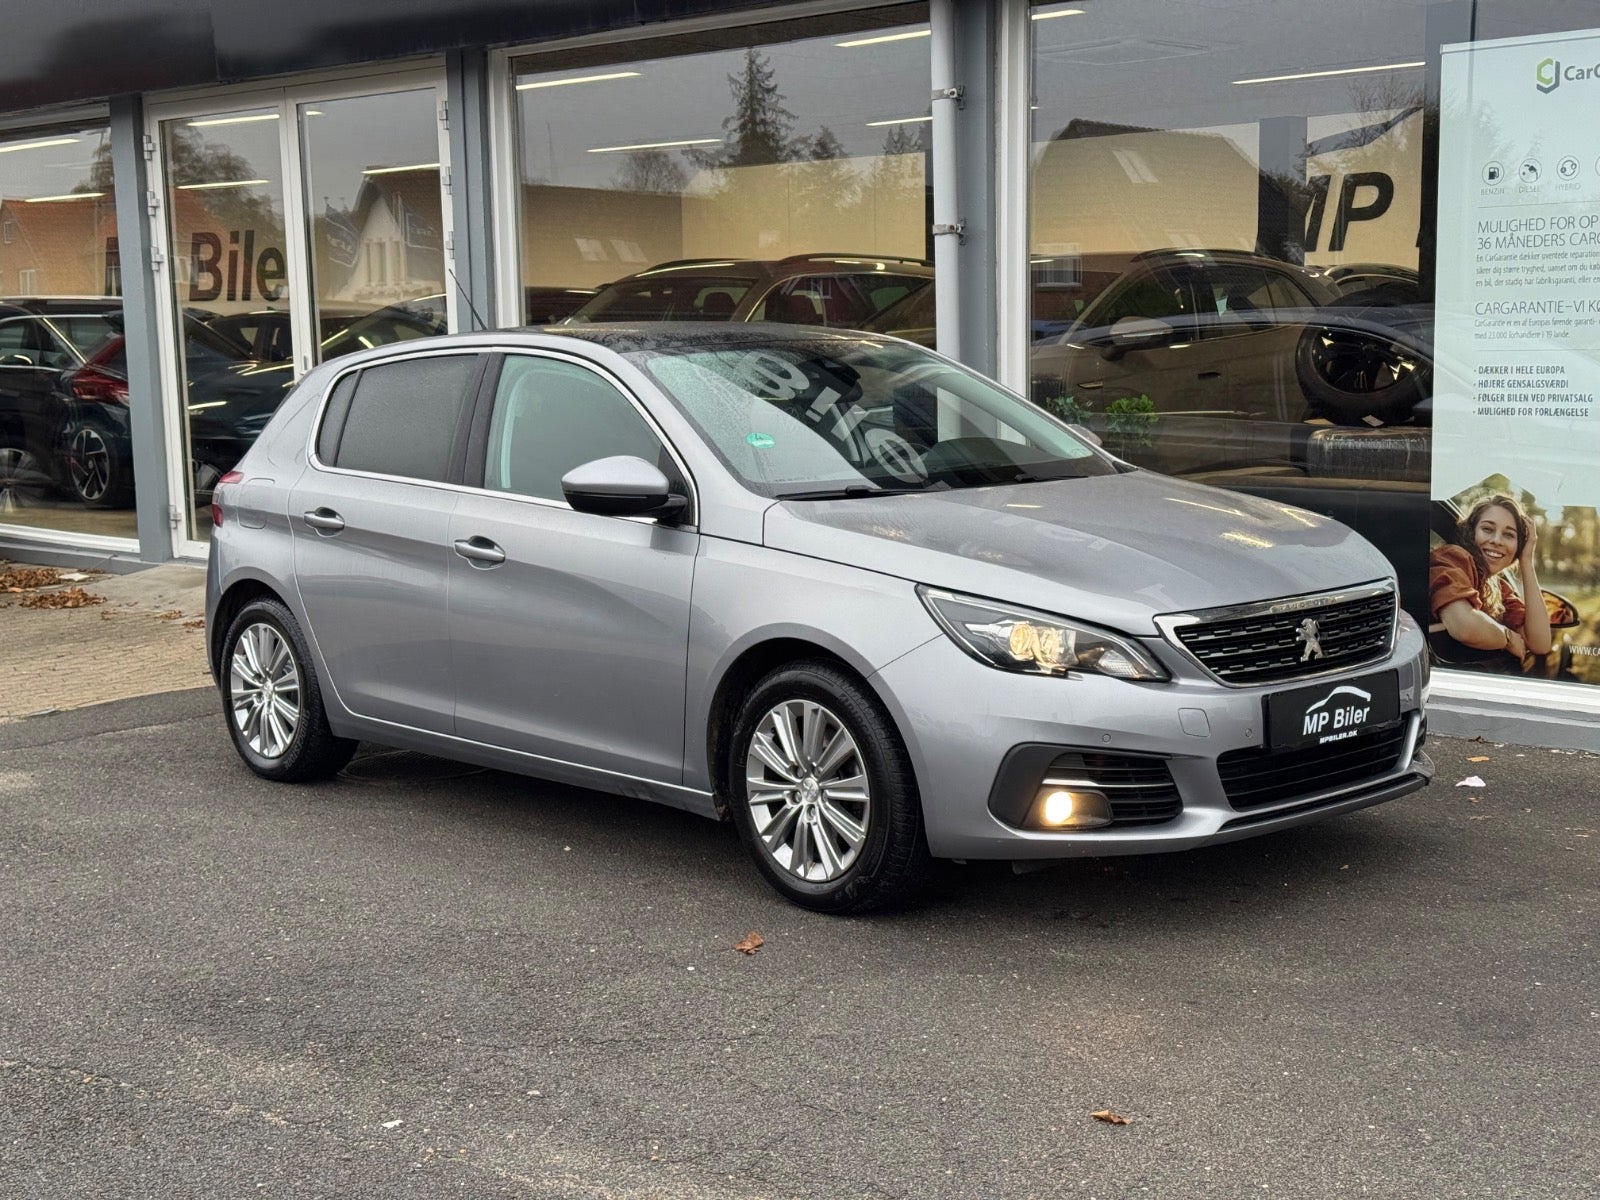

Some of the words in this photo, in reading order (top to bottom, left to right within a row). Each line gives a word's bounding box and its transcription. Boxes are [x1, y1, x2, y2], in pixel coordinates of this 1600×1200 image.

[1480, 188, 1504, 196] BENZIN
[1478, 217, 1546, 234] MULIGHED
[1550, 216, 1575, 230] FOR
[1478, 237, 1491, 250] 36
[1496, 233, 1566, 249] MÅNEDERS
[1580, 263, 1588, 271] du
[1479, 366, 1508, 374] DÆKKER
[1516, 366, 1534, 374] HELE
[1536, 366, 1565, 374] EUROPA
[1478, 379, 1505, 388] HØJERE
[1507, 380, 1568, 388] GENSALGSVÆRDI
[1478, 394, 1505, 402] FØLGER
[1507, 394, 1529, 402] BILEN
[1531, 394, 1545, 402] VED
[1548, 394, 1593, 402] PRIVATSALG
[1478, 408, 1515, 416] MULIGHED
[1518, 408, 1532, 416] FOR
[1535, 408, 1589, 416] FORLÆNGELSE
[1302, 712, 1329, 736] MP
[1333, 706, 1370, 729] Biler
[1319, 730, 1358, 744] MPBILER.DK
